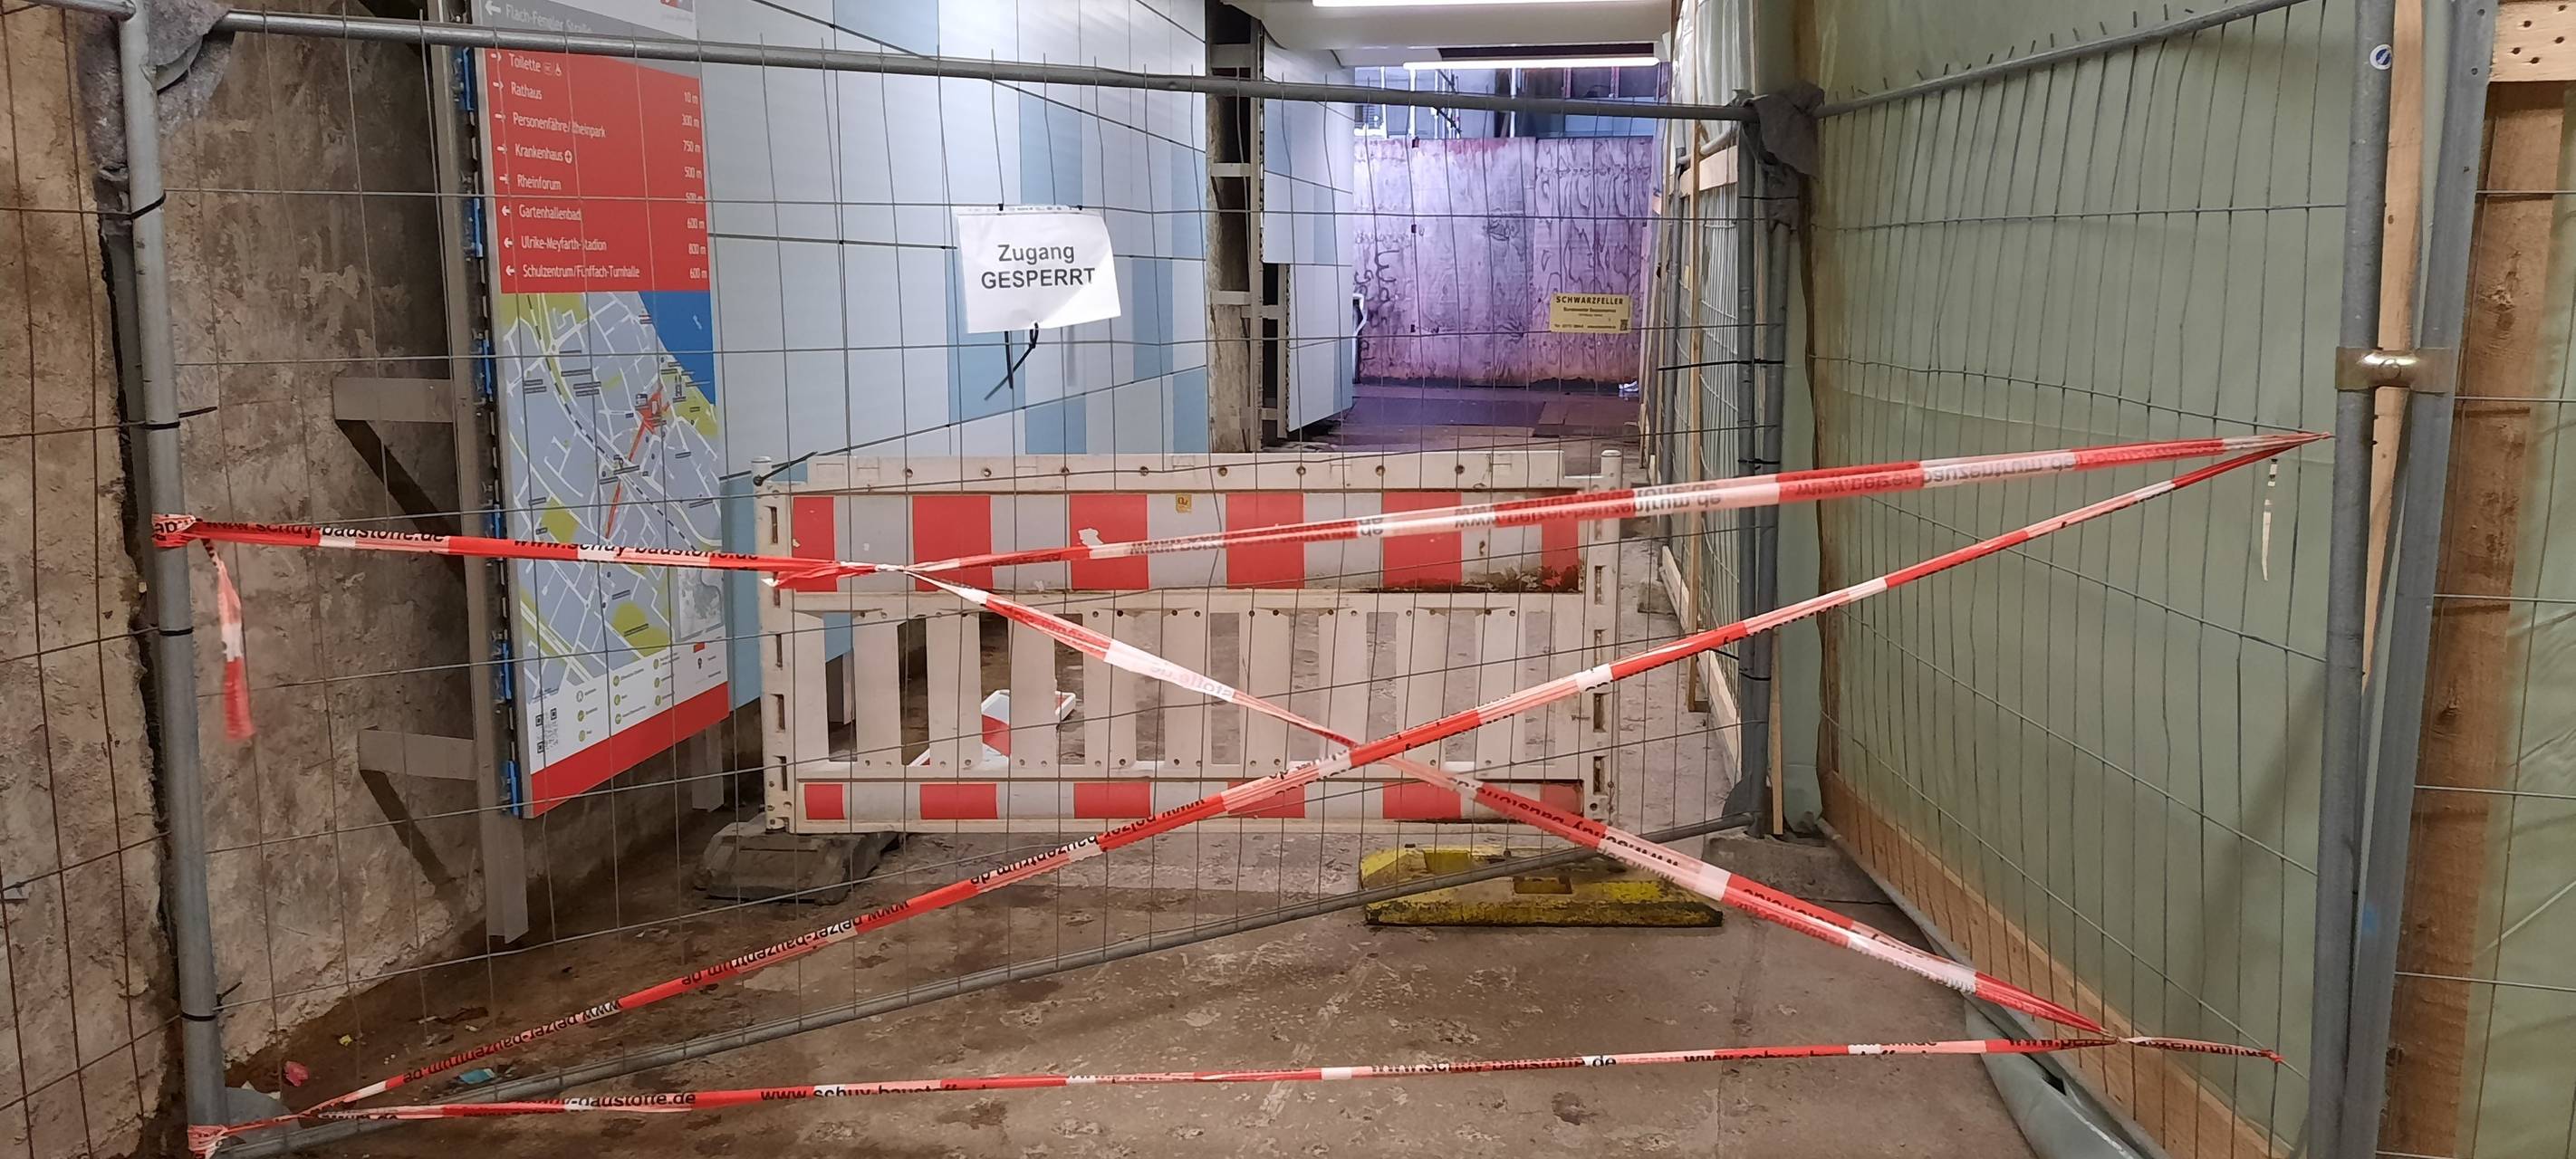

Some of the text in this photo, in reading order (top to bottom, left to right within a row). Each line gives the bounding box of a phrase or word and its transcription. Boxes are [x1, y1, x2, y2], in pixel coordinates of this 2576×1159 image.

[508, 53, 542, 72] Toilette
[511, 81, 543, 100] Rathaus
[514, 143, 563, 162] Krankenhaus
[517, 174, 562, 190] Rheinforum
[997, 244, 1075, 265] Zugang
[981, 267, 1096, 290] GESPERRT
[1555, 295, 1624, 305] SCHWARZFELLER
